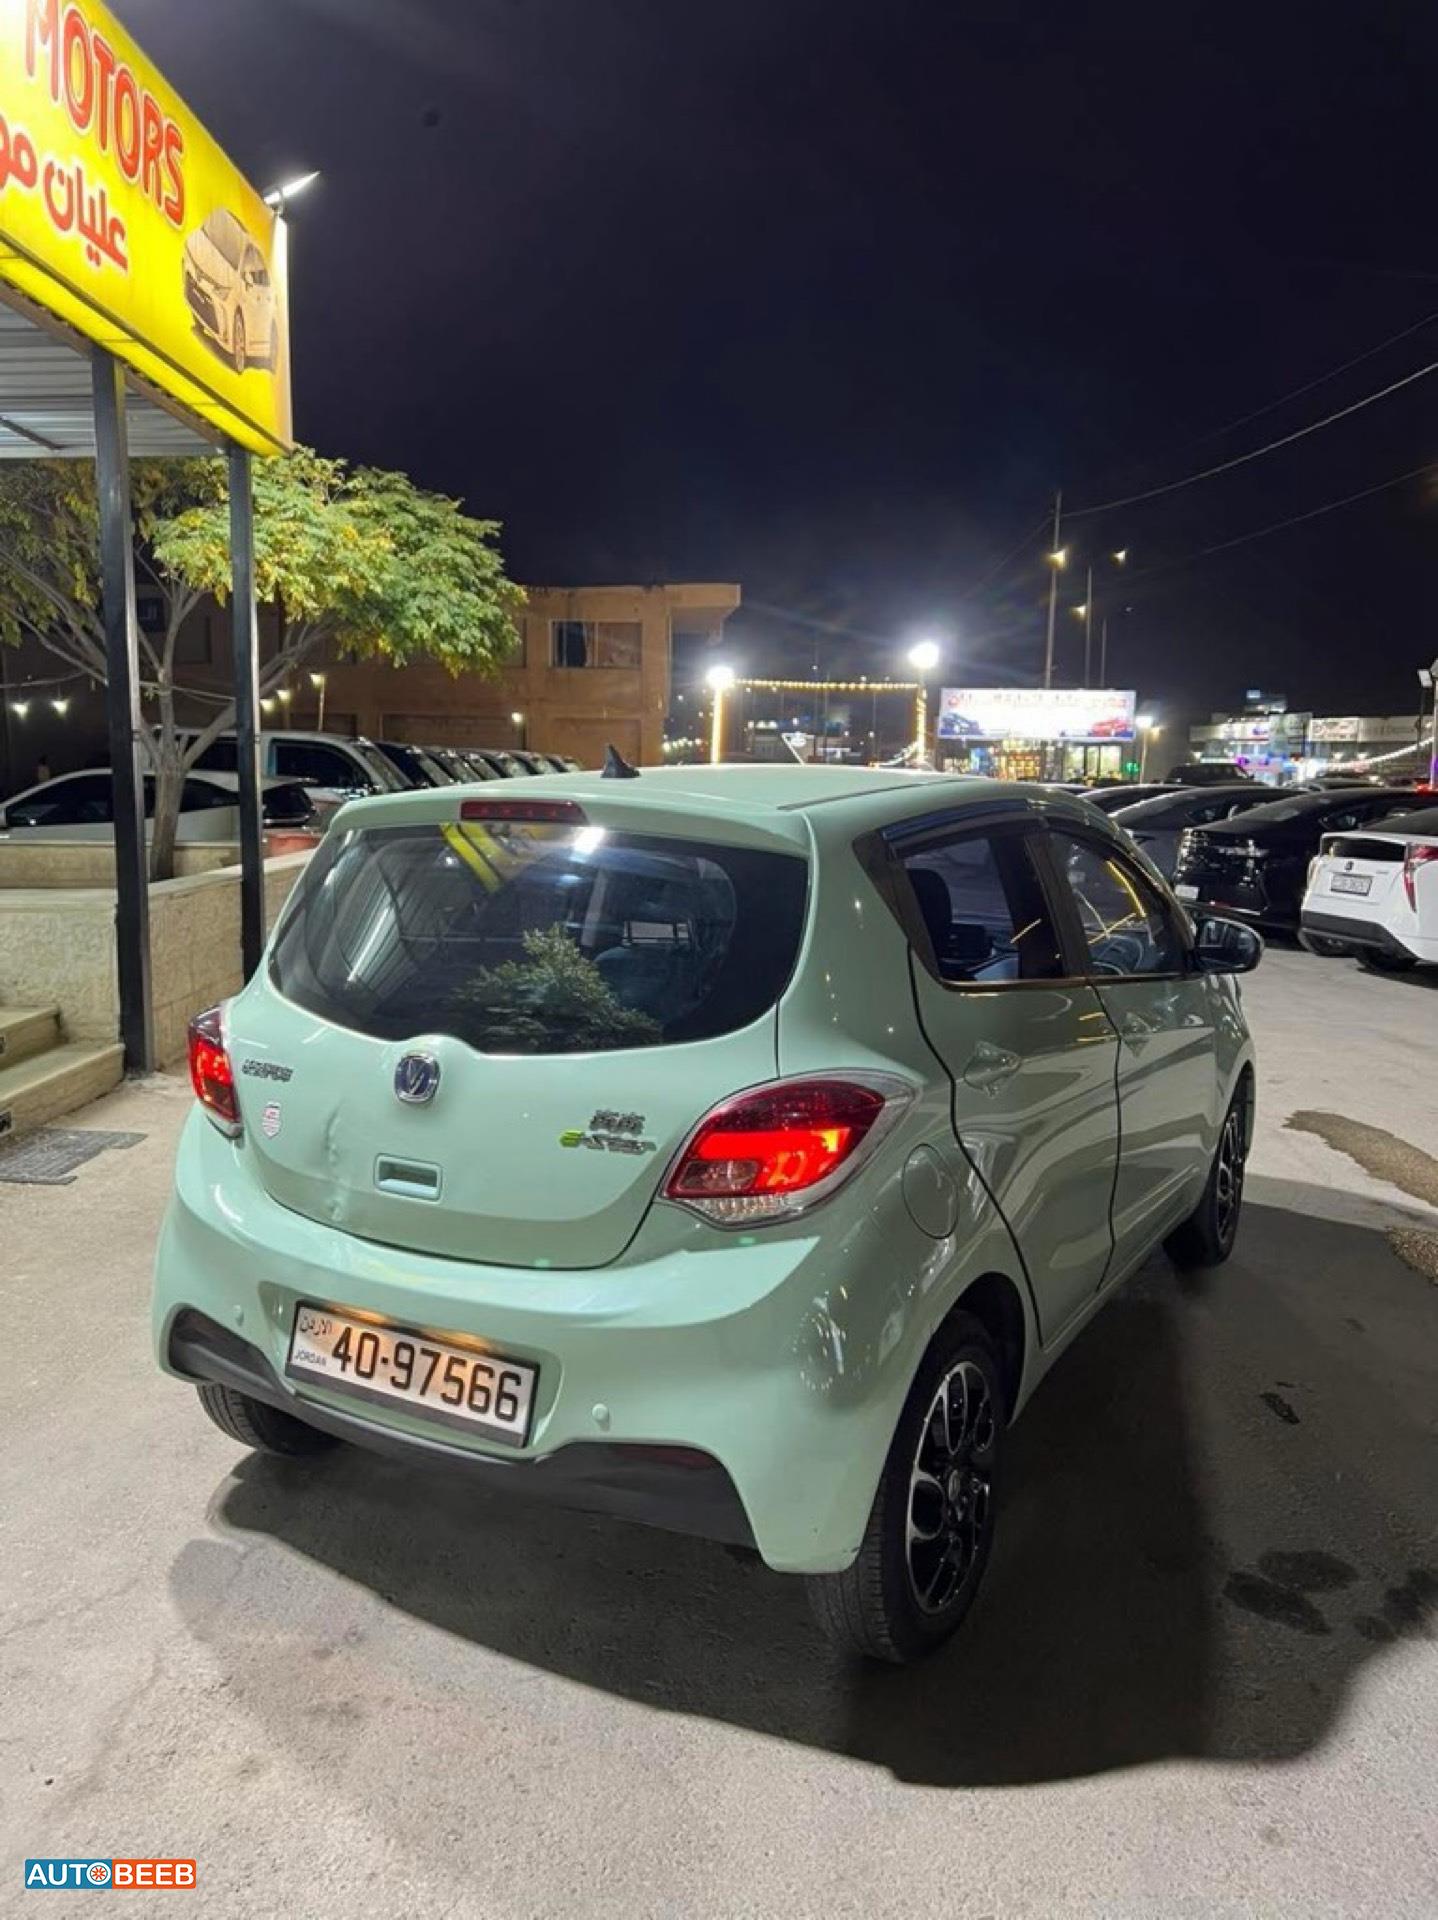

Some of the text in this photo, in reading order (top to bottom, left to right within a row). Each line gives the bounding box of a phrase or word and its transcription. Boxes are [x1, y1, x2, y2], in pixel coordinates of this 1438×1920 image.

[26, 0, 185, 226] MOTORS
[44, 161, 128, 270] عليان
[295, 1350, 327, 1366] JORDAN
[332, 1327, 521, 1422] 40-97566
